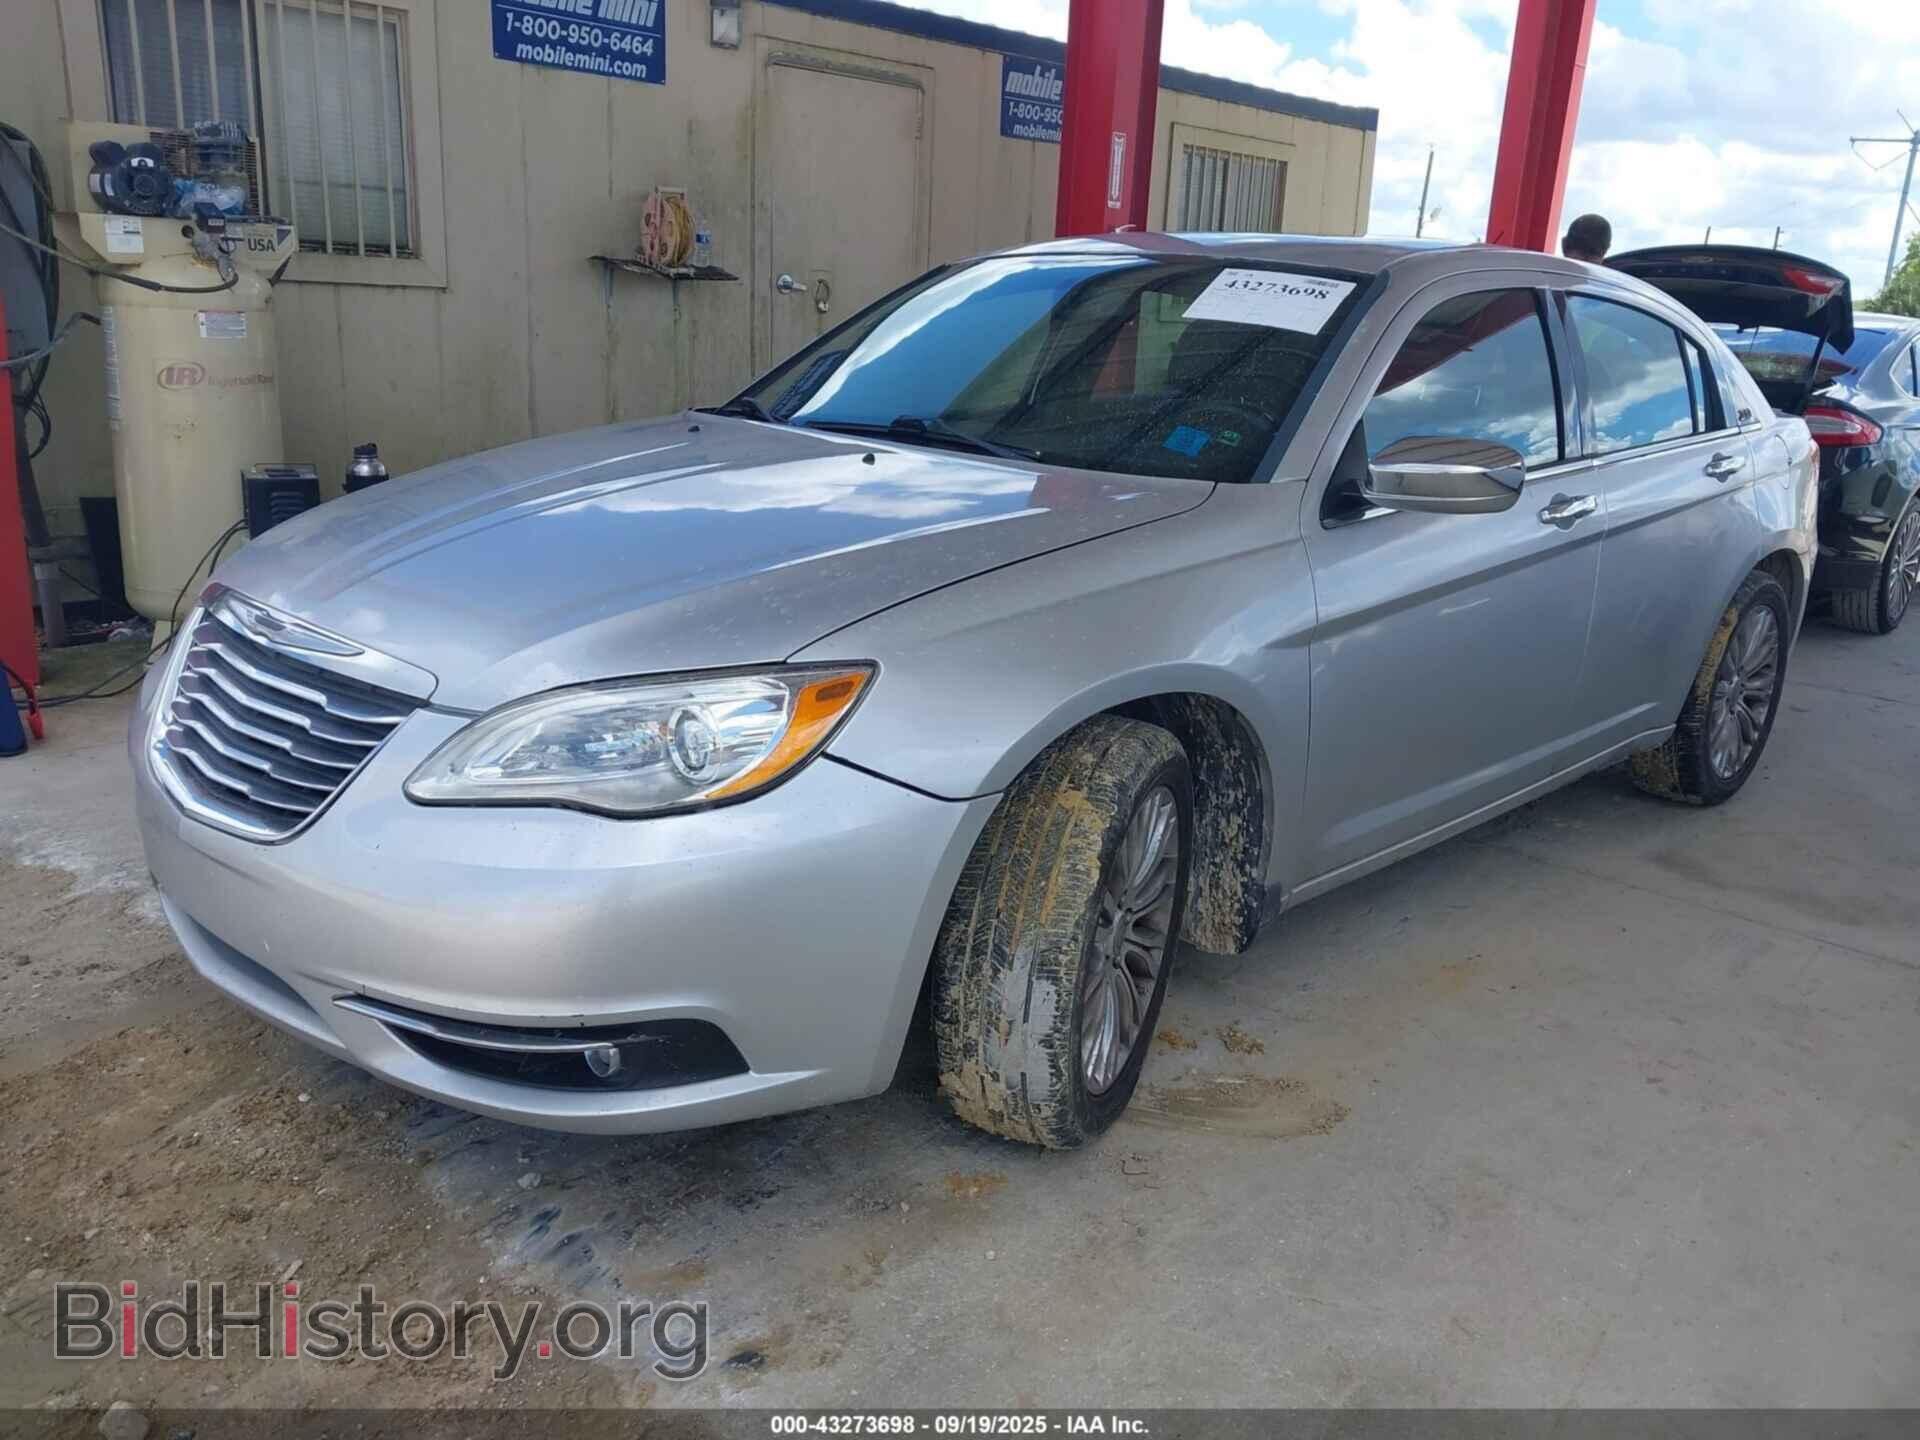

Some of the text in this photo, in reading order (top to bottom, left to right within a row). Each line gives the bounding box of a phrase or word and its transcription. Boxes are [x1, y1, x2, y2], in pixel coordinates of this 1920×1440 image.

[506, 12, 654, 56] 1-800-950-6464
[515, 43, 647, 78] mobilemini.com
[1005, 64, 1063, 100] mobile
[248, 238, 276, 252] USA
[1224, 279, 1331, 300] 43273698
